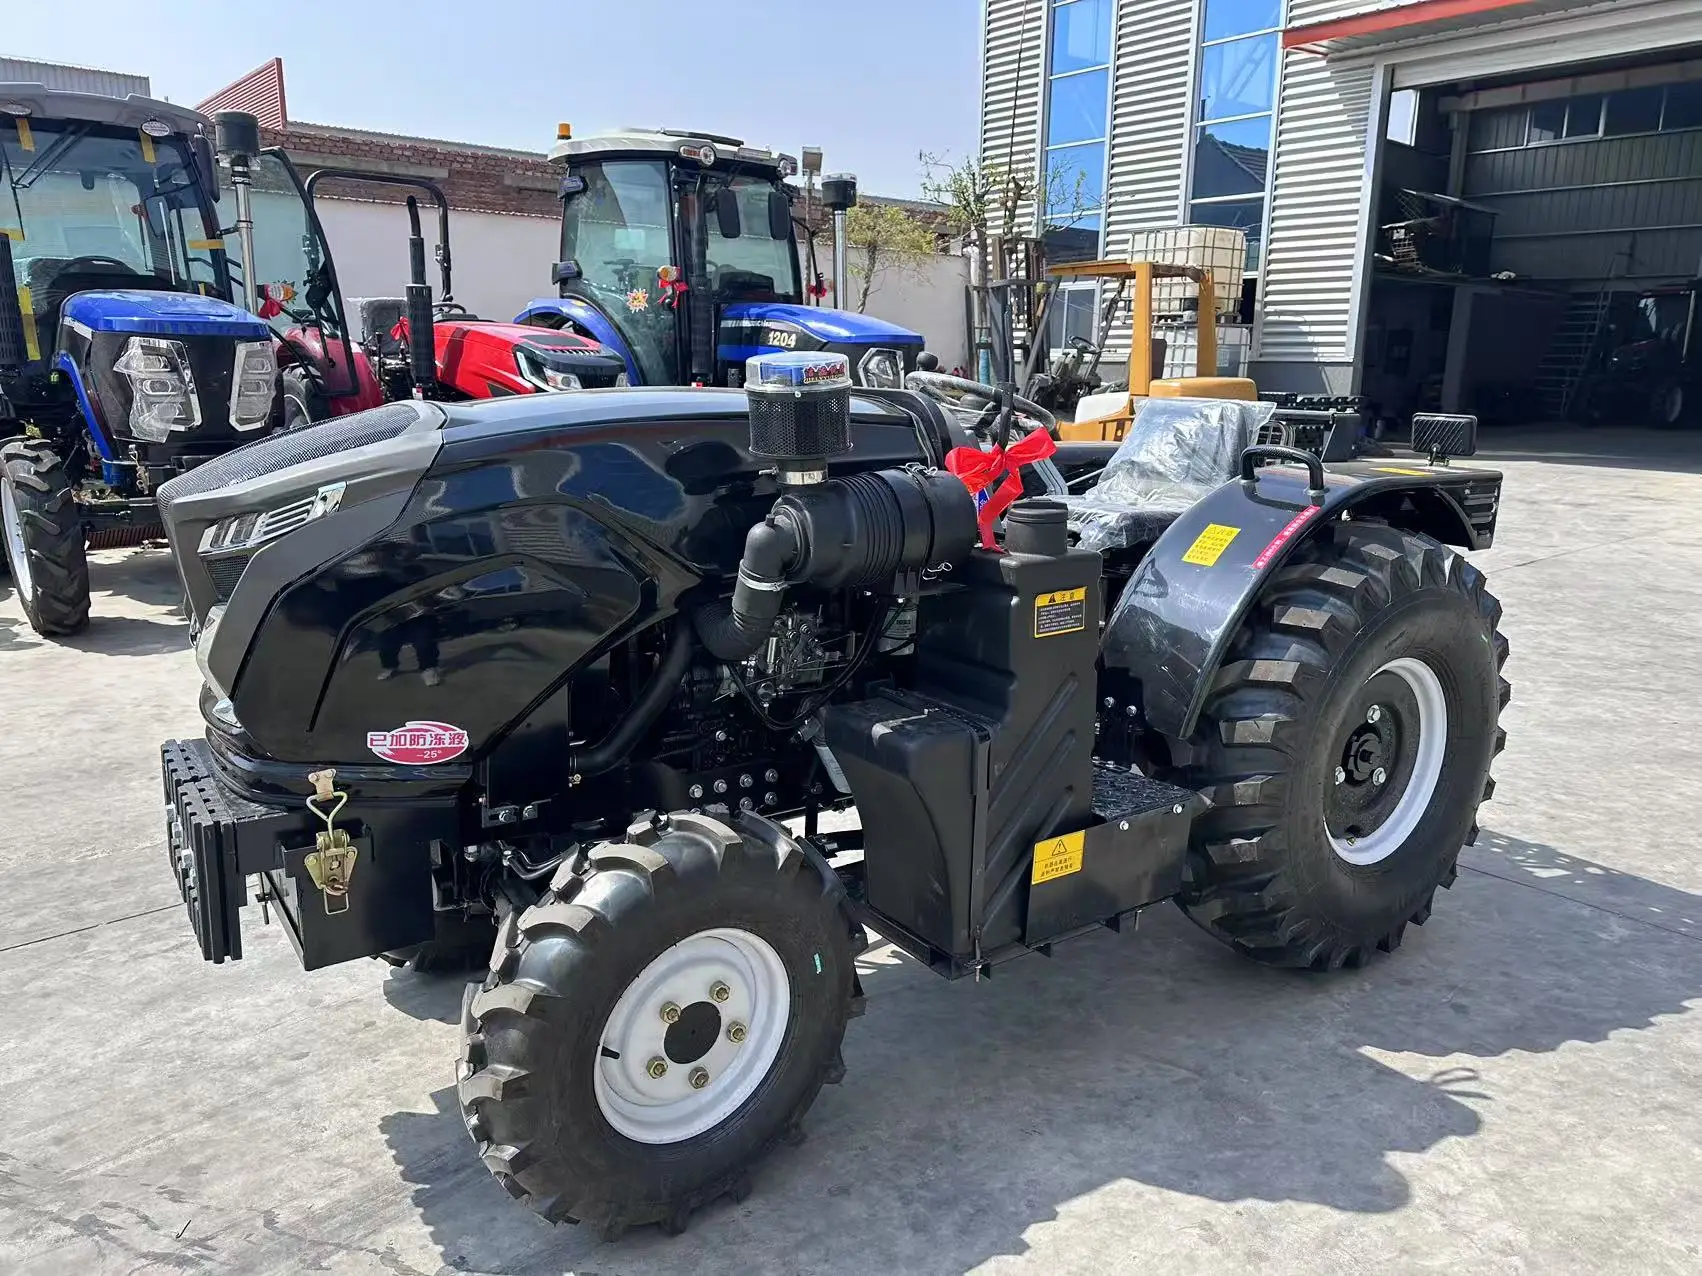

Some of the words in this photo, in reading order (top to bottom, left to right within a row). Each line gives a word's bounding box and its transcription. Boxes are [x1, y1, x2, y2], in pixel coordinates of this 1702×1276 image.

[768, 331, 797, 348] 1204
[368, 732, 466, 747] 已加防冻液
